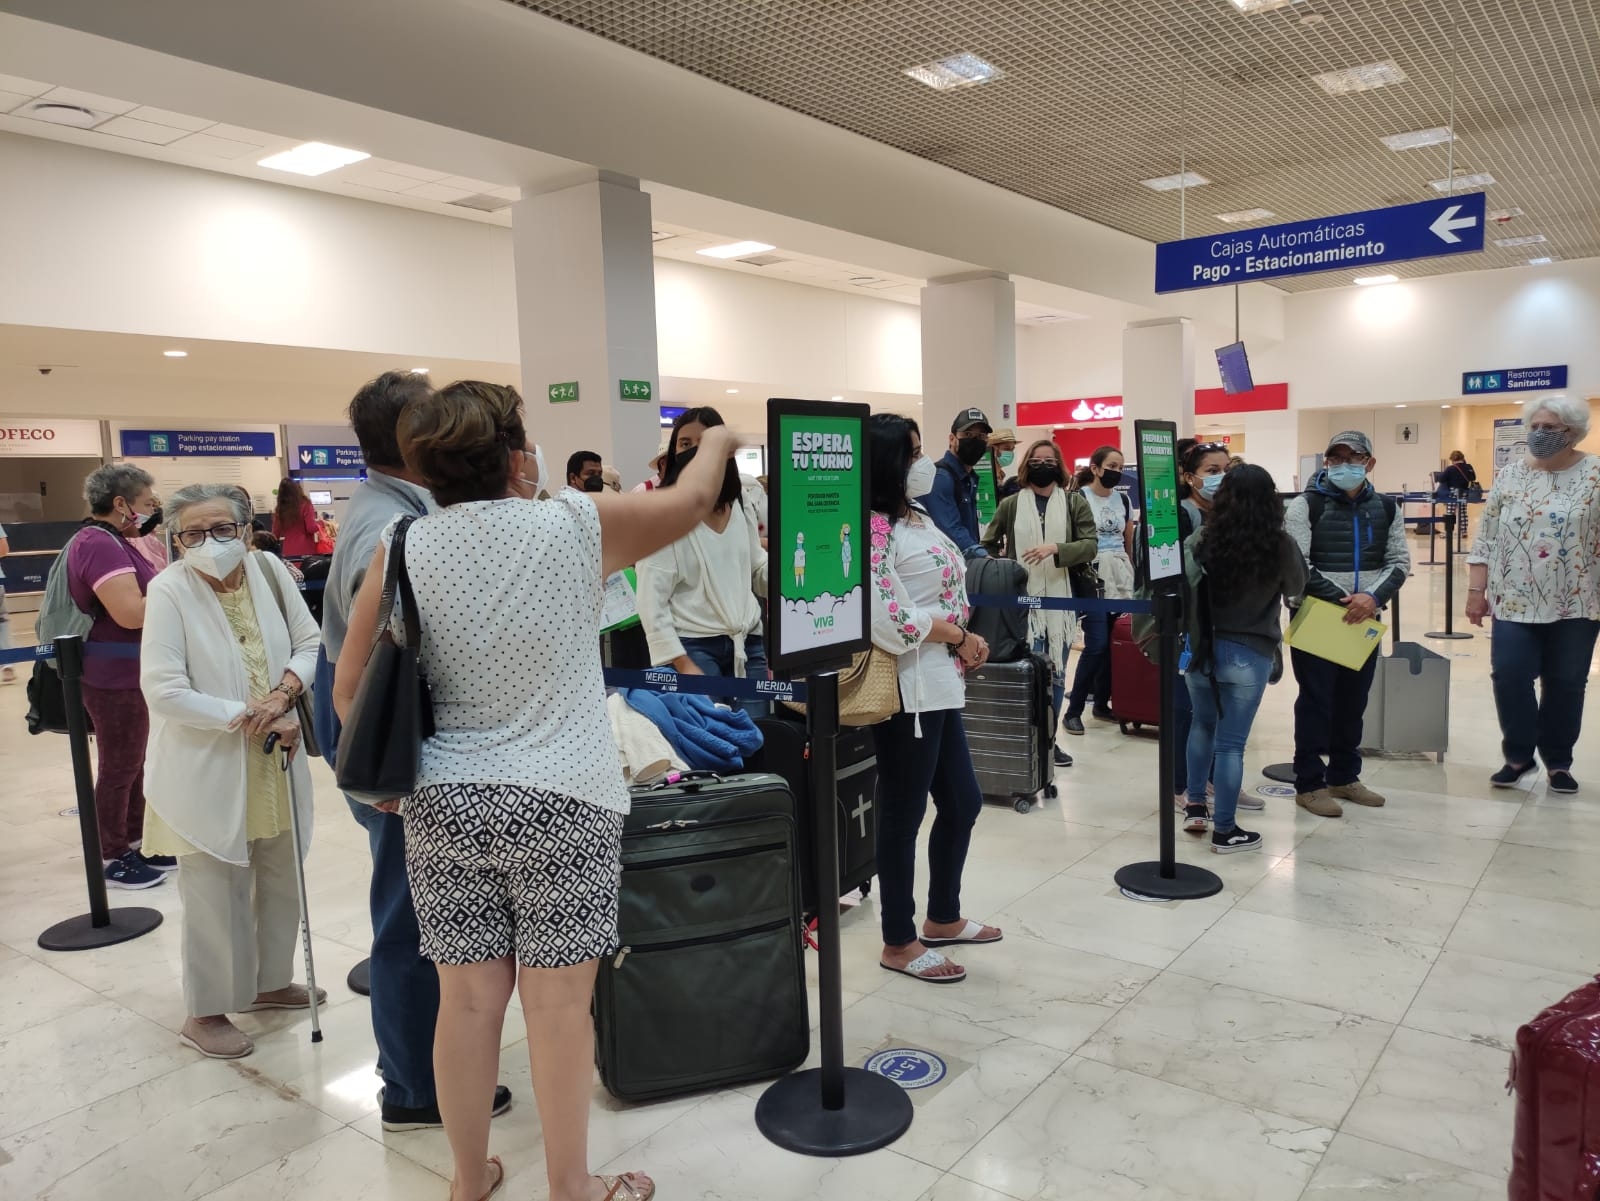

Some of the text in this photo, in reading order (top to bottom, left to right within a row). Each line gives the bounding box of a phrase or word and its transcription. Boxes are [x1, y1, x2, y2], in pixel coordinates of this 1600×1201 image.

[1210, 222, 1365, 259] Cajas Automáticas
[1192, 263, 1231, 281] Pago
[1245, 241, 1385, 272] Estacionamiento
[1507, 370, 1551, 379] Restrooms
[1507, 379, 1551, 388] Sanitarios
[178, 434, 204, 444] Parking
[205, 436, 217, 444] pay
[792, 431, 853, 453] ESPERA
[178, 444, 197, 452] Pago
[336, 448, 357, 457] Parking
[792, 453, 853, 470] TU TURNO
[645, 672, 678, 683] MERIDA
[756, 680, 793, 692] MERIDA
